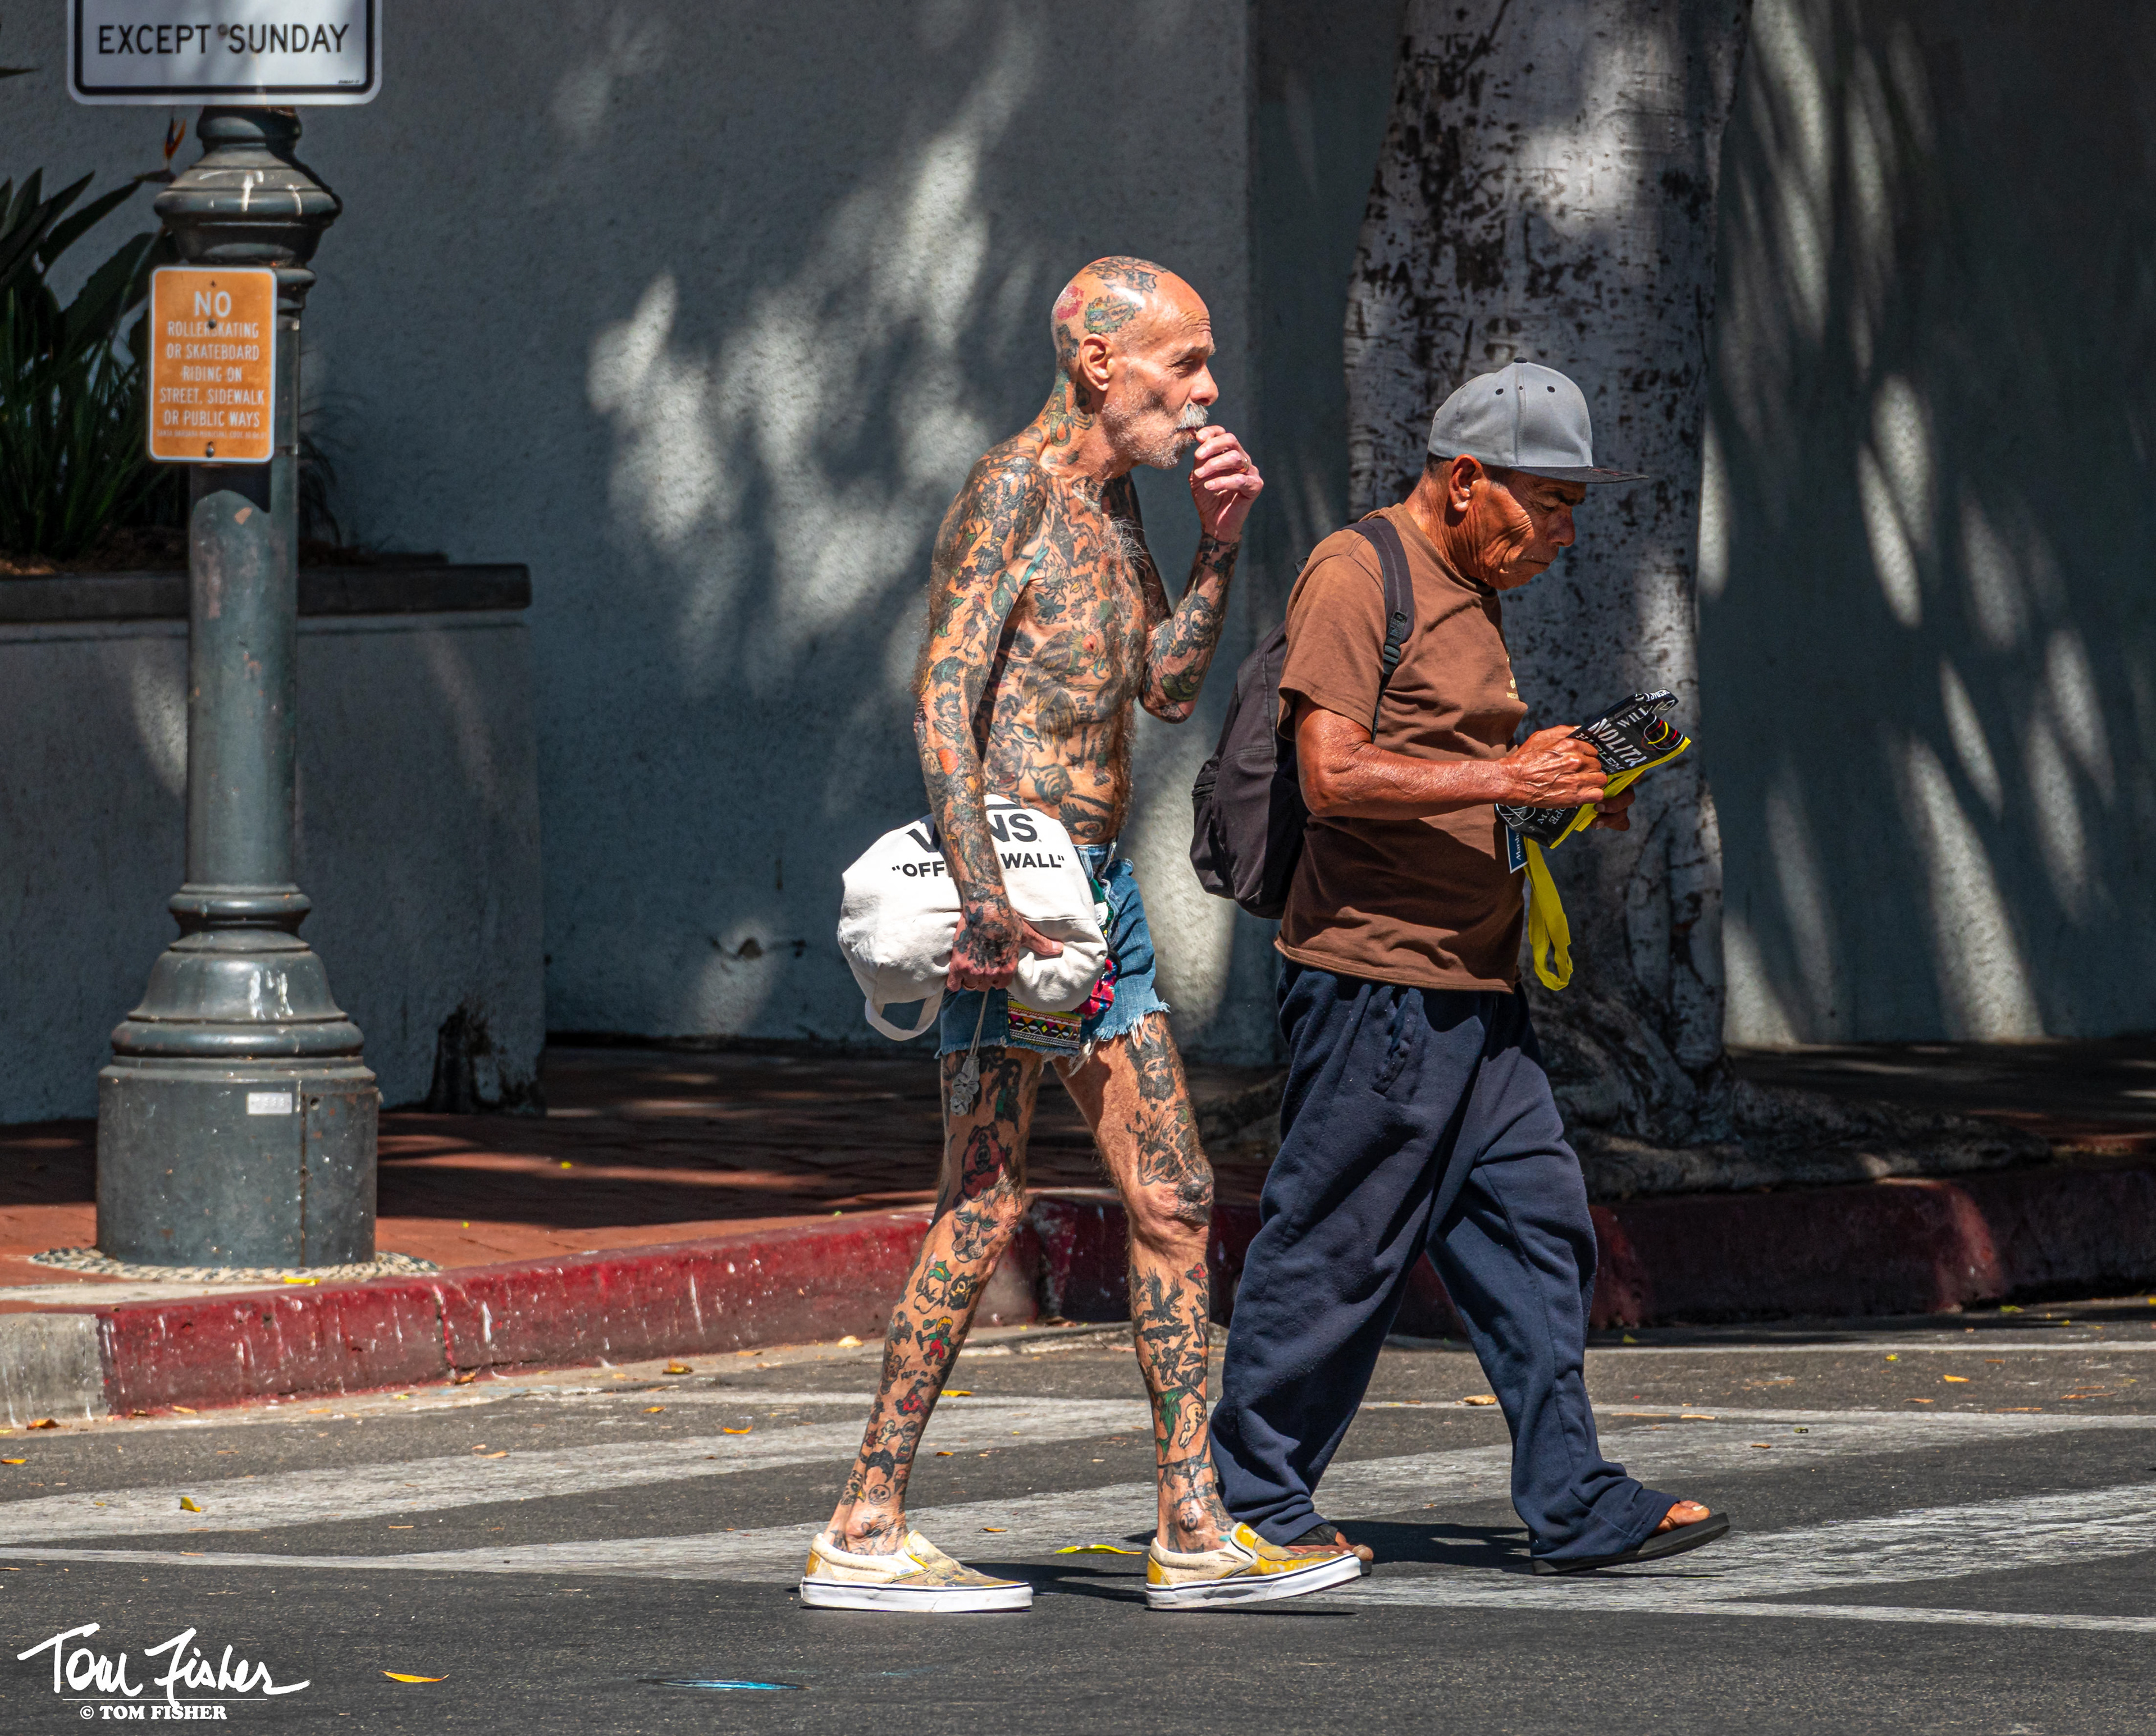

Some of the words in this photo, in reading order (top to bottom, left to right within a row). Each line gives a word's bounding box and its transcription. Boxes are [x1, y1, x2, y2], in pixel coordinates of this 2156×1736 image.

[99, 24, 212, 54] EXCEPT
[228, 23, 350, 54] SUNDAY
[194, 291, 232, 317] NO
[167, 321, 259, 339] ROLLERKATING
[167, 342, 181, 359] OR
[186, 344, 259, 361] SKATEBOARD
[182, 366, 222, 382] RIDING
[227, 367, 242, 382] ON
[160, 387, 203, 405] STREET,
[207, 388, 264, 405] SIDEWALK
[164, 409, 179, 426] OR
[184, 410, 225, 427] PUBLIC
[229, 412, 259, 428] WAYS
[1588, 718, 1647, 768] NOLITA
[906, 813, 1038, 853] VNS
[1001, 853, 1065, 869] WALL"
